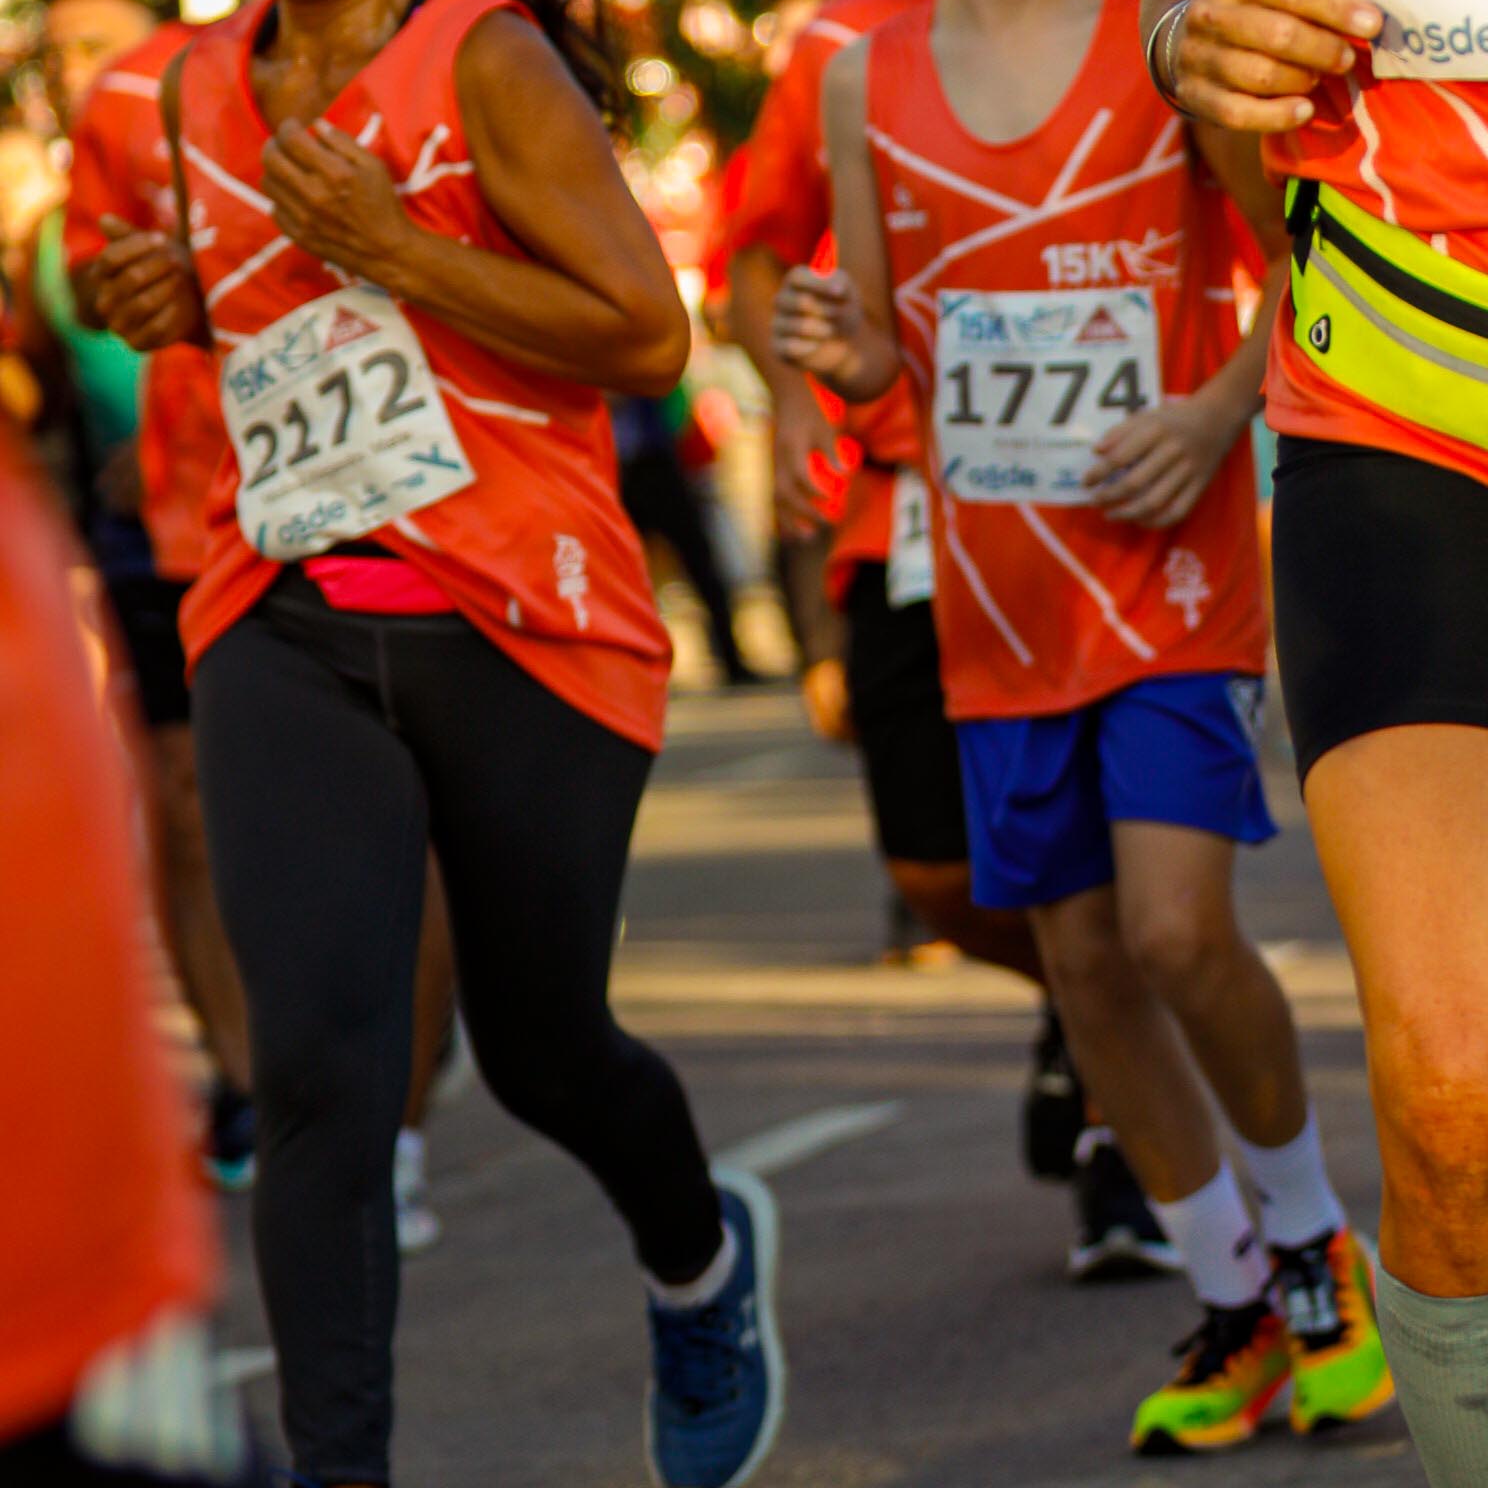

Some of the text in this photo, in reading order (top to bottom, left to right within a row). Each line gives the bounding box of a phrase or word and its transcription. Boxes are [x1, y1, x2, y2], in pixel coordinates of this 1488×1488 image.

[1040, 242, 1119, 285] 15K
[243, 348, 427, 489] 2172
[944, 359, 1147, 426] 1774
